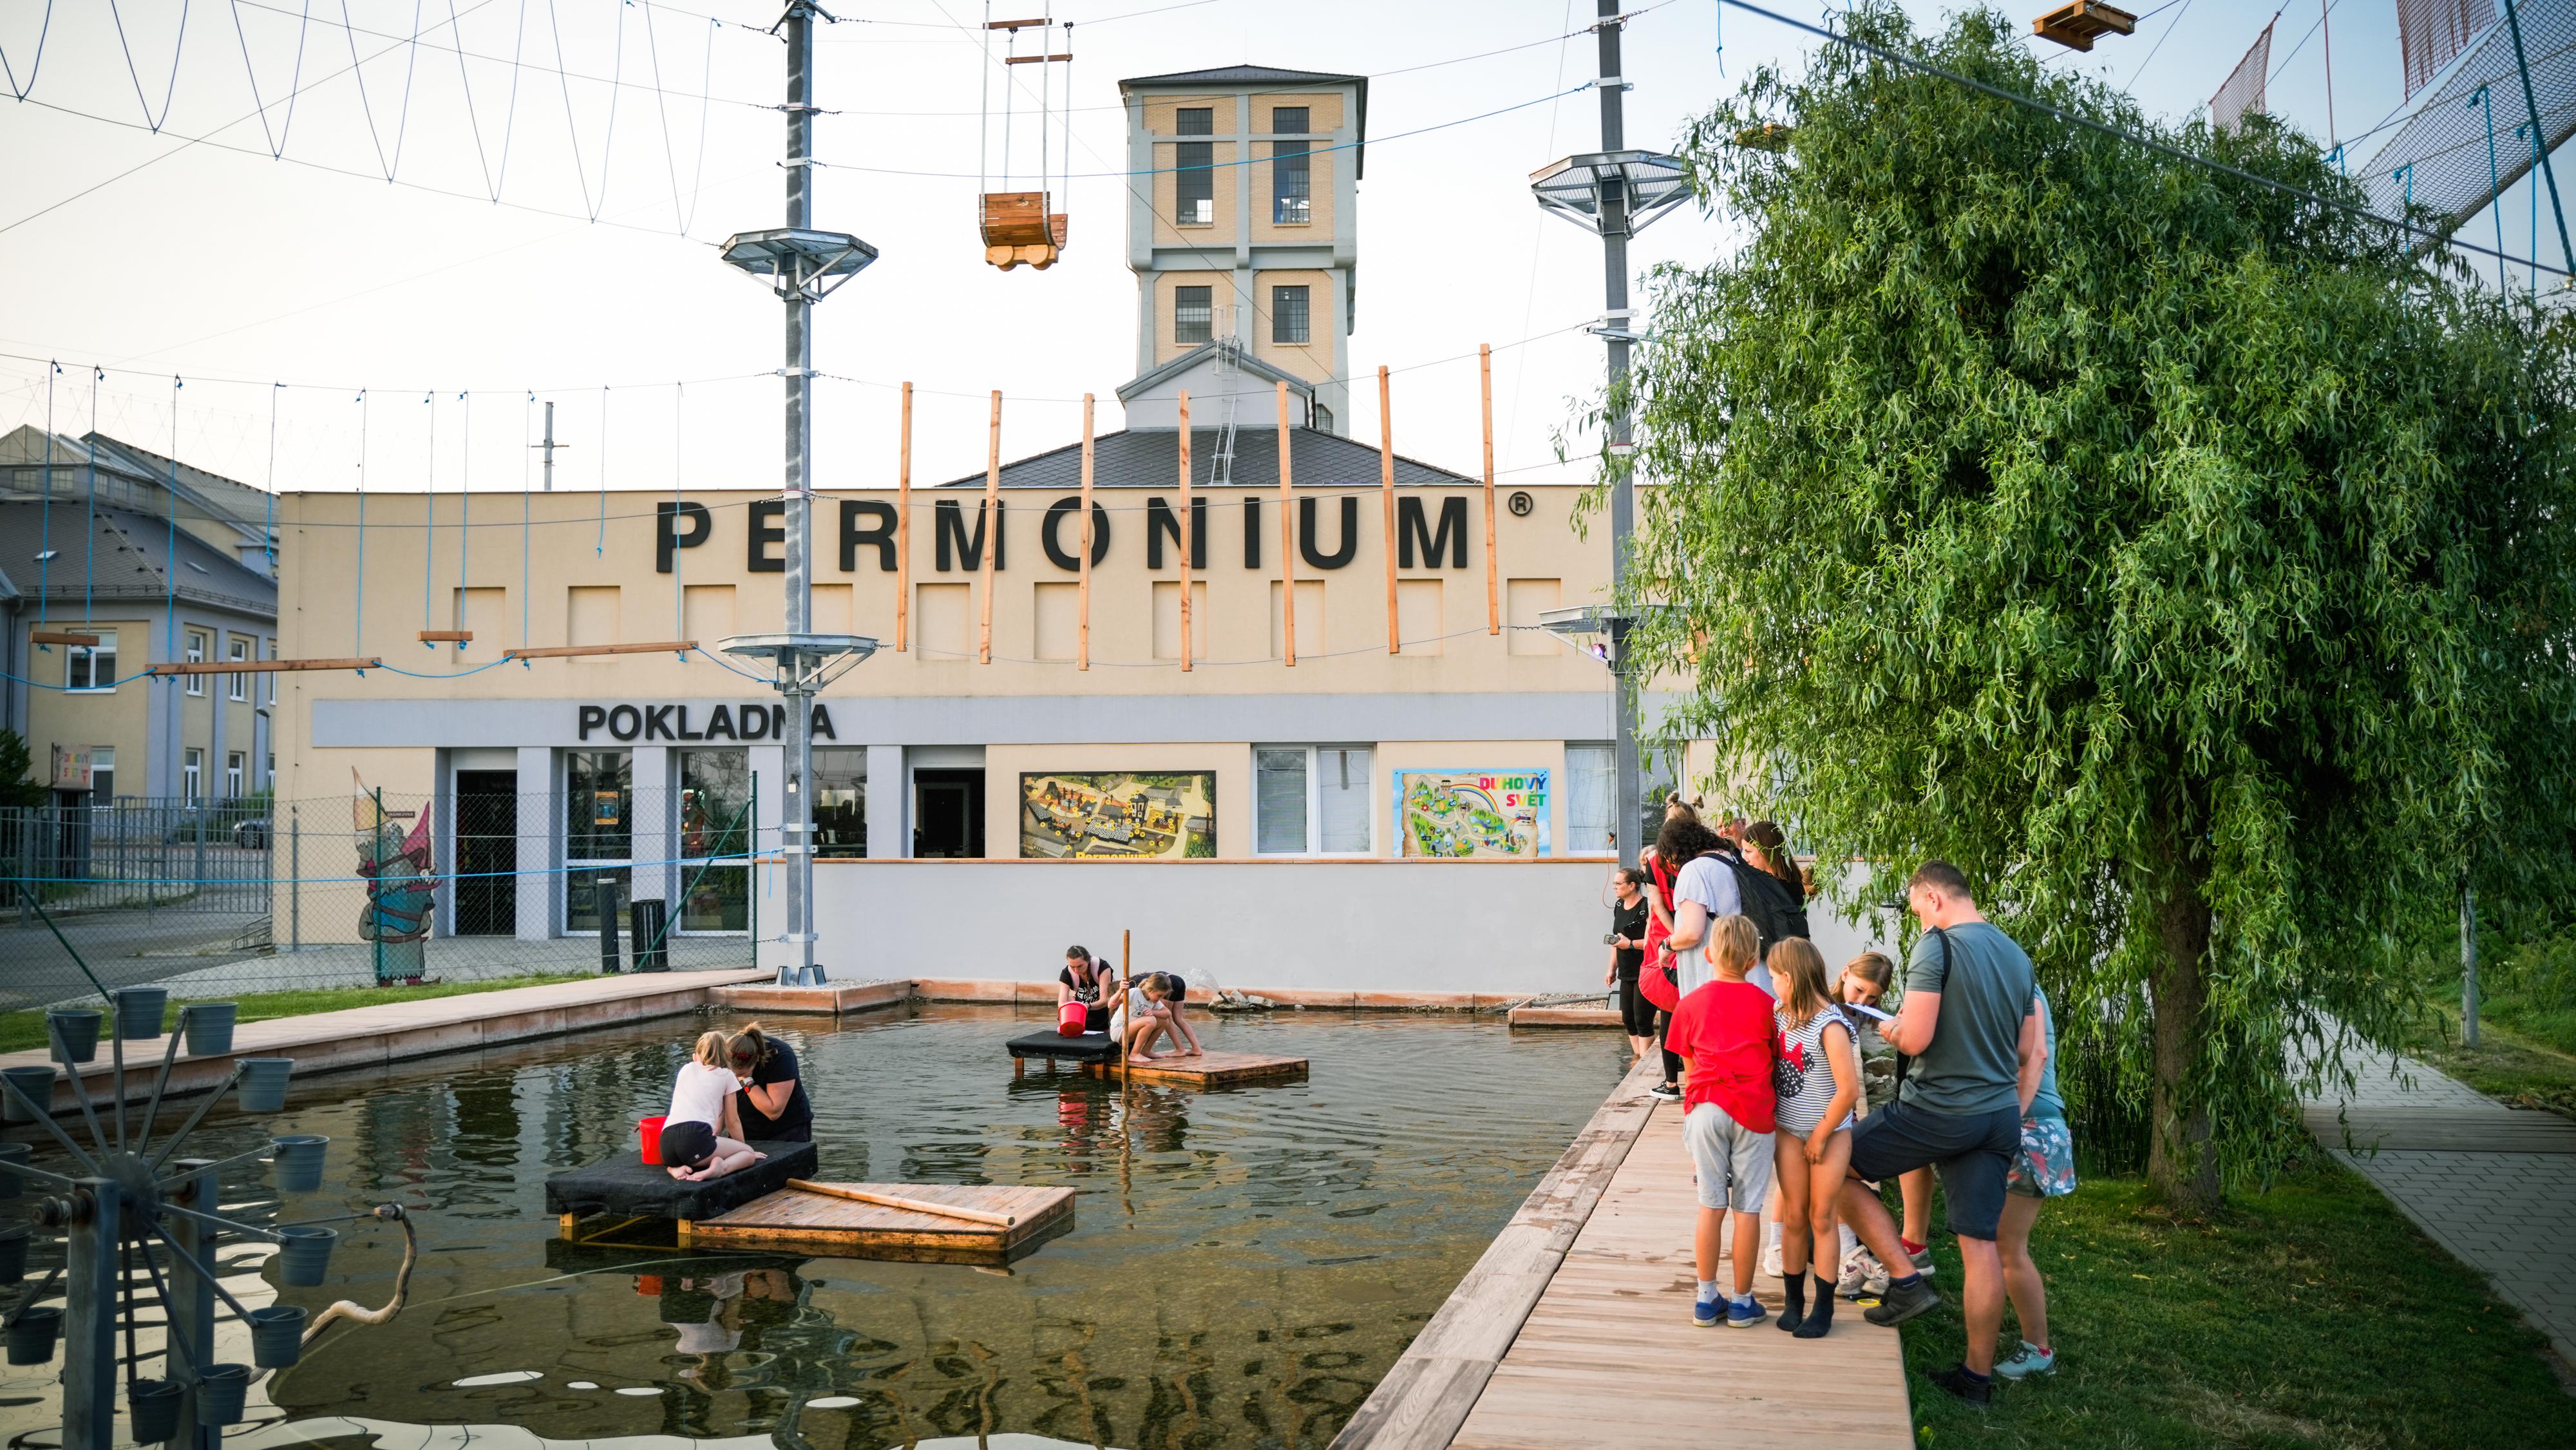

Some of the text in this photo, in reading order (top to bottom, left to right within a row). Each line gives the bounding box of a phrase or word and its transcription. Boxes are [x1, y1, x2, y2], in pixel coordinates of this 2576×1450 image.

[656, 496, 1468, 573] PERMONIUM
[1479, 774, 1547, 790] DUHOVÝ
[1506, 790, 1546, 806] SVĚT
